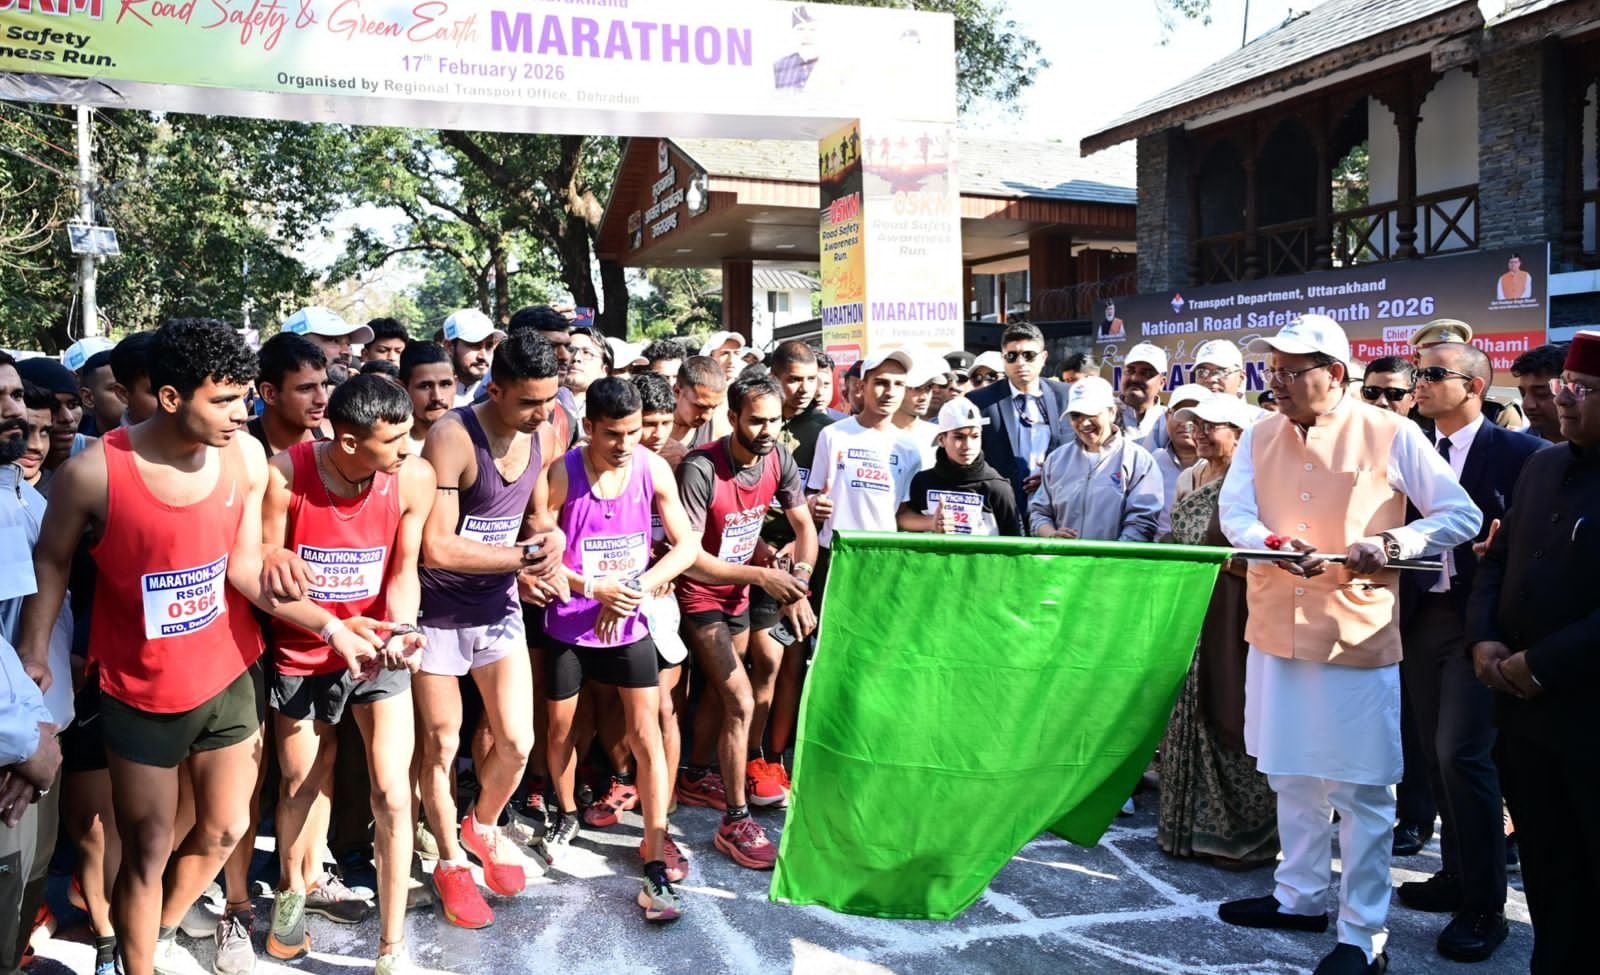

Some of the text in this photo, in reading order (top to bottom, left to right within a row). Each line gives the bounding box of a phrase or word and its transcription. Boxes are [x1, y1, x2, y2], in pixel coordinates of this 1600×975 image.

[202, 0, 291, 51] Safety
[327, 0, 403, 42] Green
[407, 1, 480, 49] Earth
[6, 26, 91, 49] Safety
[490, 10, 753, 67] MARATHON
[62, 49, 117, 68] Run.
[438, 57, 518, 82] February
[523, 63, 566, 81] 2026
[277, 71, 357, 90] Organised
[361, 78, 380, 93] by
[384, 79, 450, 95] Regional
[455, 83, 522, 99] Transport
[1188, 278, 1387, 311] Transport Department, Uttarakhand
[823, 303, 863, 327] MARATHON
[871, 302, 958, 321] MARATHON
[1141, 318, 1198, 336] National
[1203, 314, 1242, 331] Road
[1377, 297, 1435, 319] 2026
[1386, 327, 1409, 340] Chief
[1358, 342, 1417, 357] Pushkar
[1473, 337, 1529, 353] Dhami
[482, 533, 507, 543] RSGM
[315, 574, 365, 588] 0344
[323, 566, 359, 575] RSGM
[176, 583, 213, 600] RSGM
[168, 590, 216, 618] 0366
[163, 624, 187, 633] RTO,
